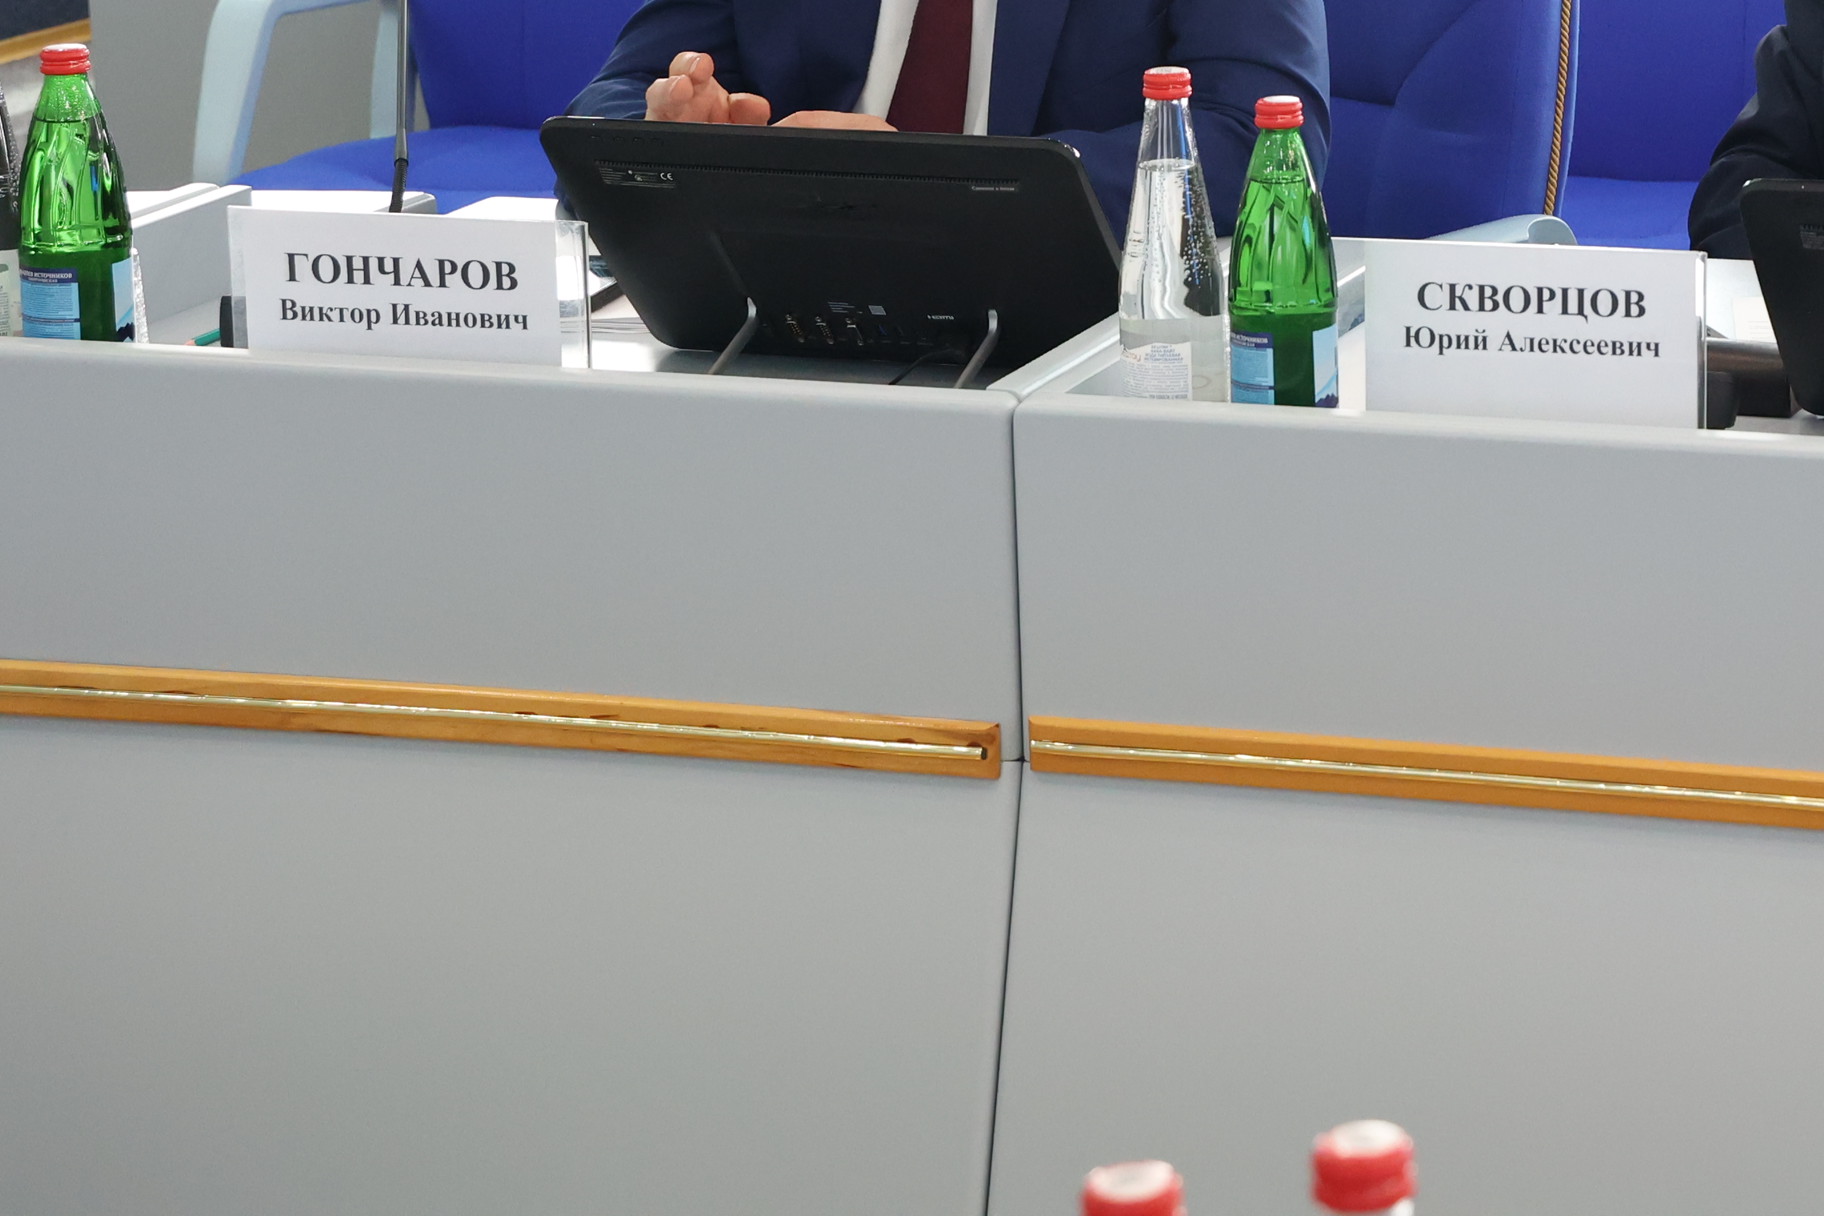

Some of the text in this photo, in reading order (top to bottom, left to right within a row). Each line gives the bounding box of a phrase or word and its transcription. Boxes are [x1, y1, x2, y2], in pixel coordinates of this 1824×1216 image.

[284, 251, 519, 292] ГОНЧАРОВ
[279, 298, 529, 331] Виктор Иванович
[1417, 281, 1647, 323] СКВОРЦОВ
[1403, 325, 1661, 358] Юрий Алексеевич
